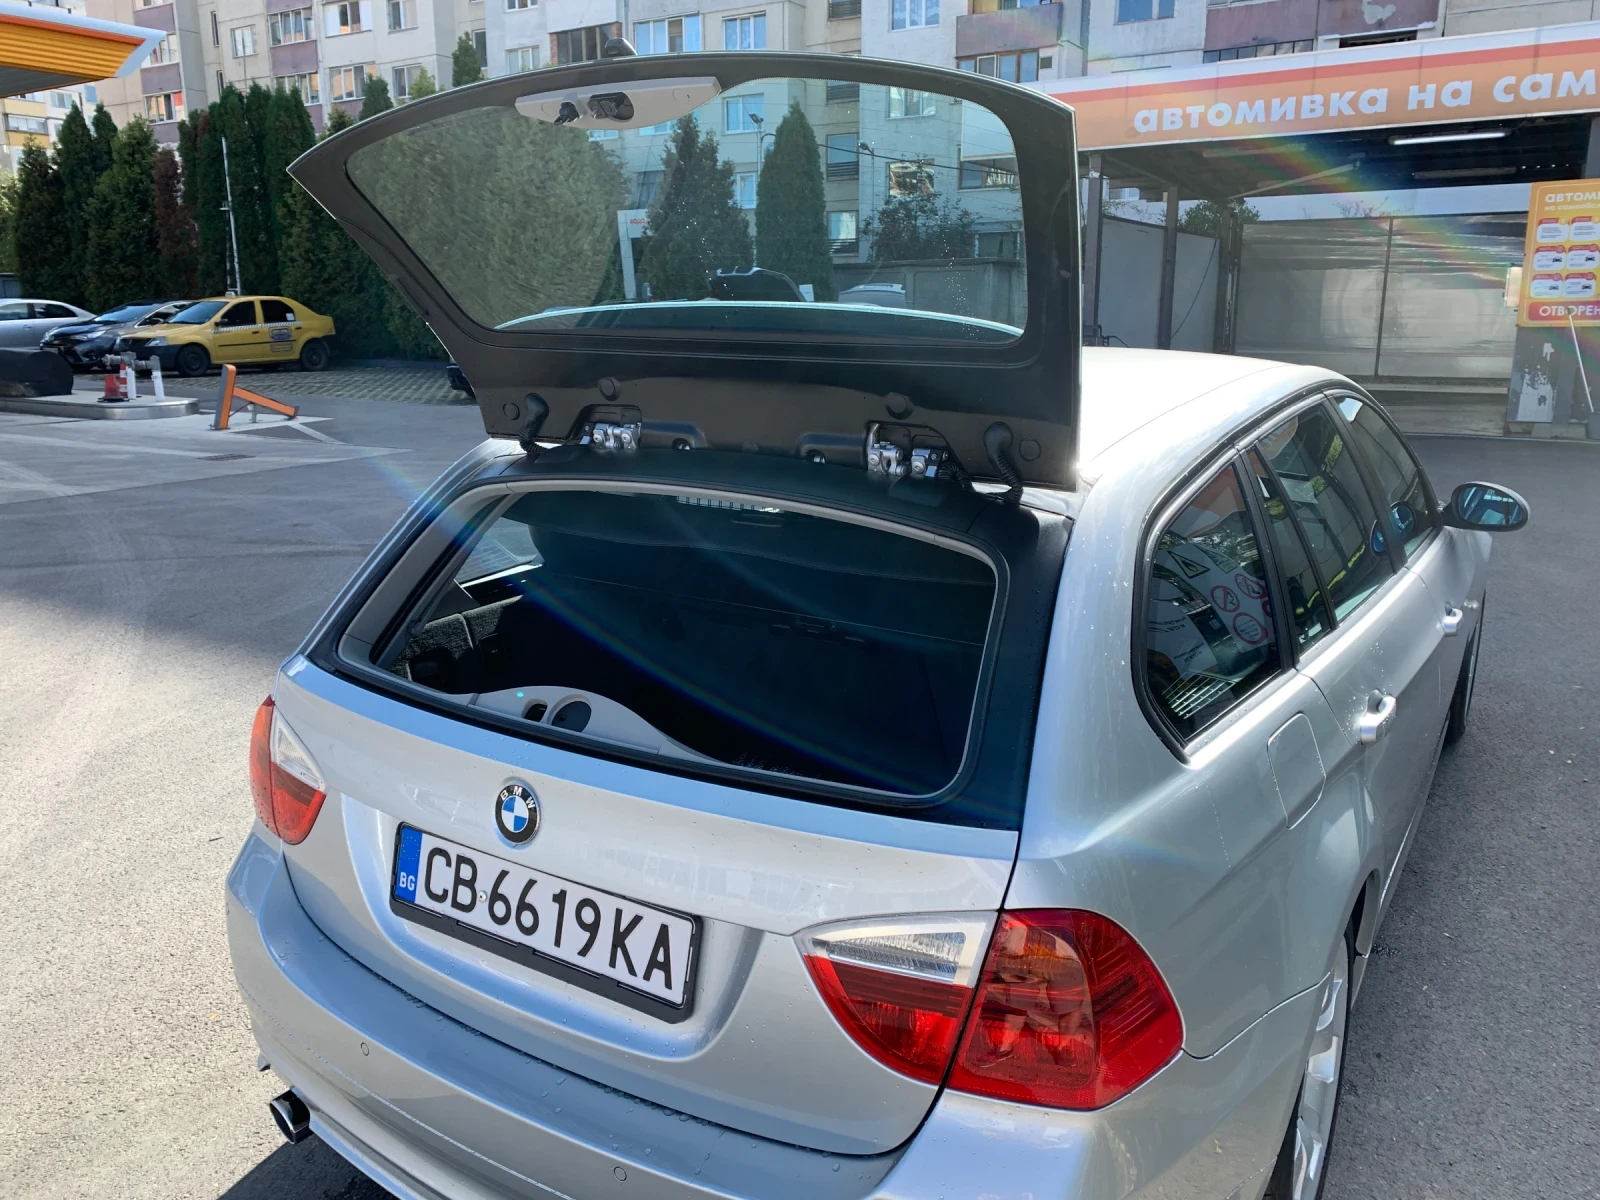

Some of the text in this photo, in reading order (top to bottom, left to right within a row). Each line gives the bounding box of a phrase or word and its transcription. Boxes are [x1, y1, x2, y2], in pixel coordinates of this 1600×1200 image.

[1133, 68, 1597, 133] автомивка на сам
[1545, 191, 1600, 203] автом
[500, 785, 536, 809] BMW
[399, 871, 416, 891] BG
